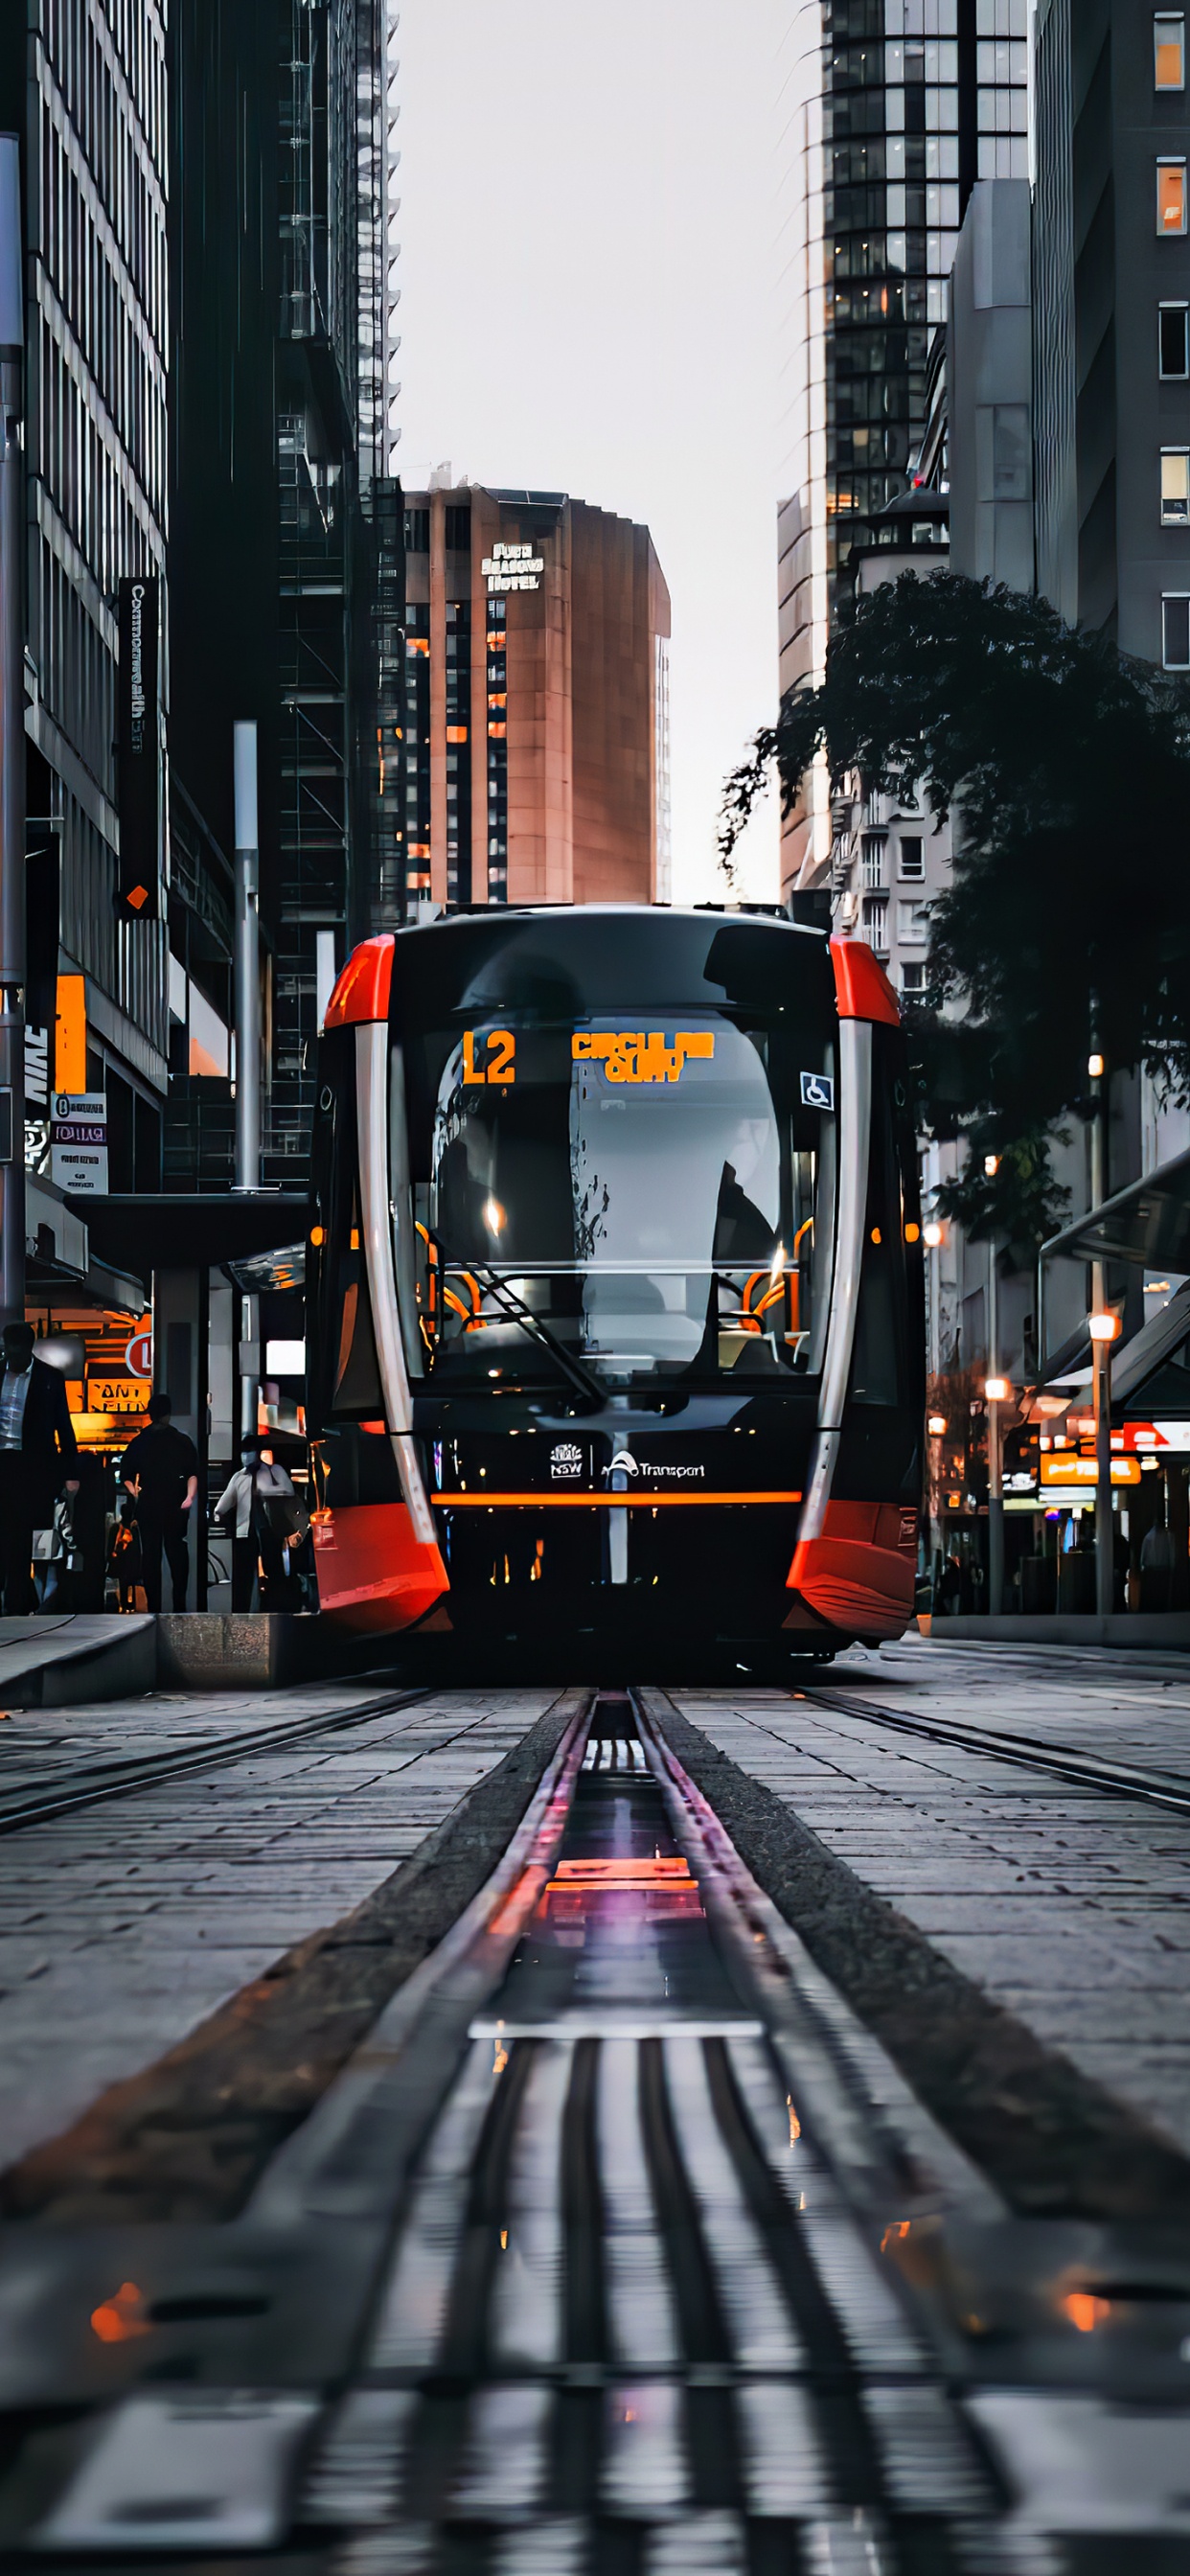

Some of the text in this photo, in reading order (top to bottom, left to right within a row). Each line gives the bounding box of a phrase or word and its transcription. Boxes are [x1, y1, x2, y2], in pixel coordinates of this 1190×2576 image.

[463, 1030, 515, 1084] L2
[571, 1032, 715, 1059] CIRCUL
[24, 1024, 48, 1105] NIKE
[550, 1462, 583, 1478] NSW
[639, 1462, 705, 1478] Transport
